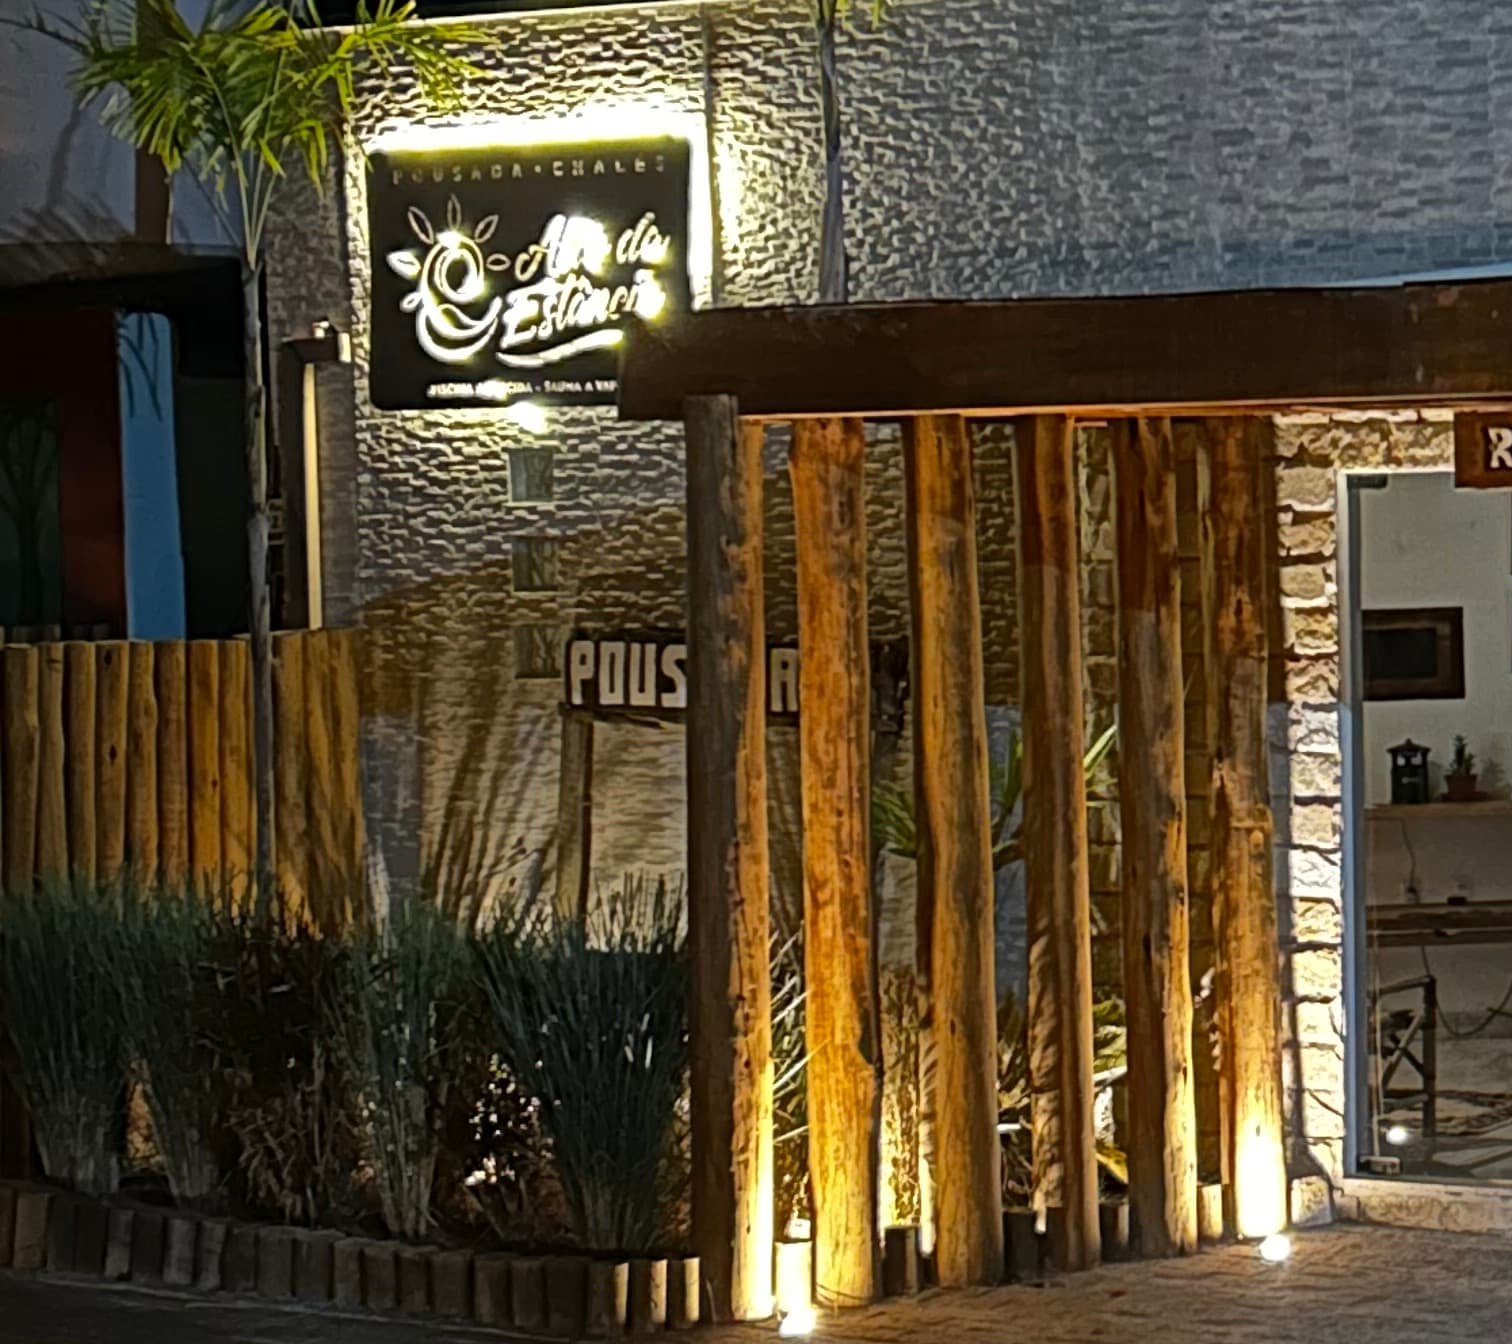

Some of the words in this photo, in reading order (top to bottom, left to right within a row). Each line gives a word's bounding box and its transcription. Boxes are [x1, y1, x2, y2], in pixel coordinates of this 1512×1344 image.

[615, 211, 671, 266] da
[500, 268, 666, 349] Estânci
[570, 639, 799, 713] POUSA
